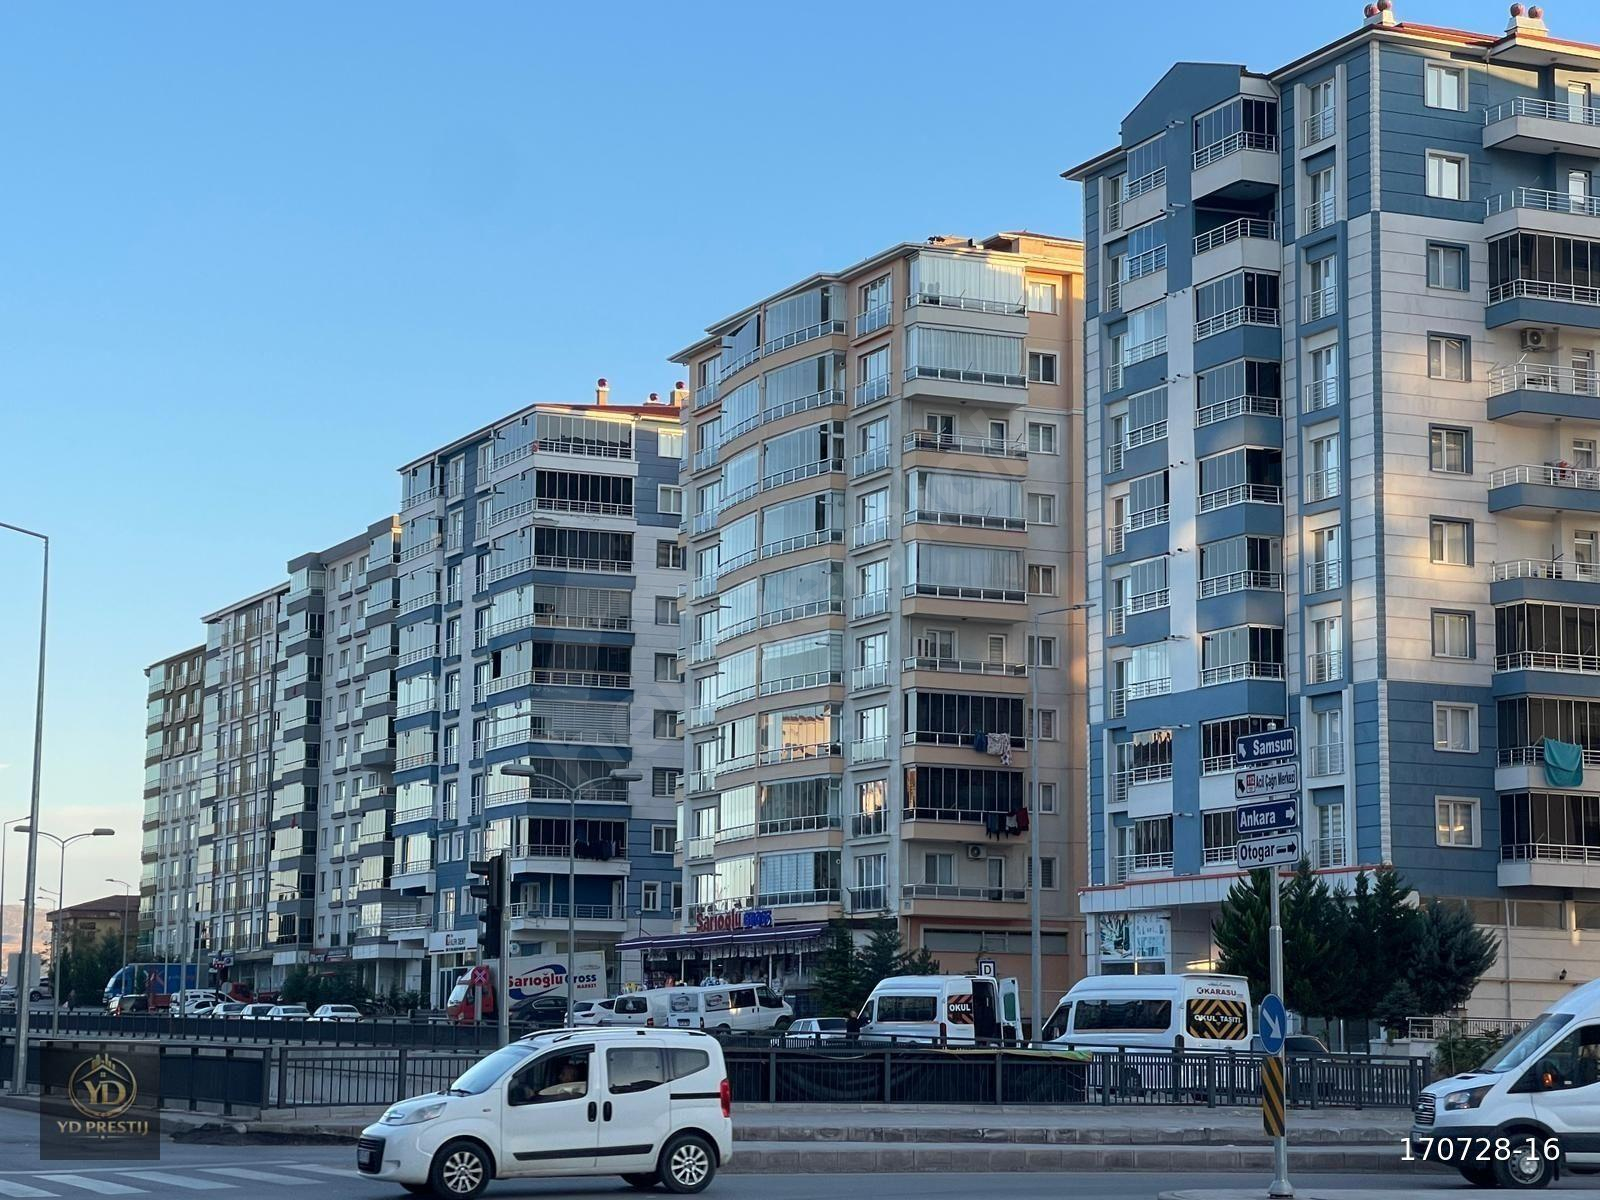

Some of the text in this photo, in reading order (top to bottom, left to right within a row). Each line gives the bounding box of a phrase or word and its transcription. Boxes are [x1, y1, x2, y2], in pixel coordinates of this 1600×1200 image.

[1252, 737, 1293, 756] Samsun
[1256, 774, 1265, 788] Acil
[1278, 770, 1296, 786] Merkezi
[1240, 811, 1276, 828] Ankara
[1240, 844, 1276, 862] Otogar
[984, 965, 992, 975] D
[949, 1003, 971, 1012] OKUL
[1194, 1014, 1217, 1022] OKUL
